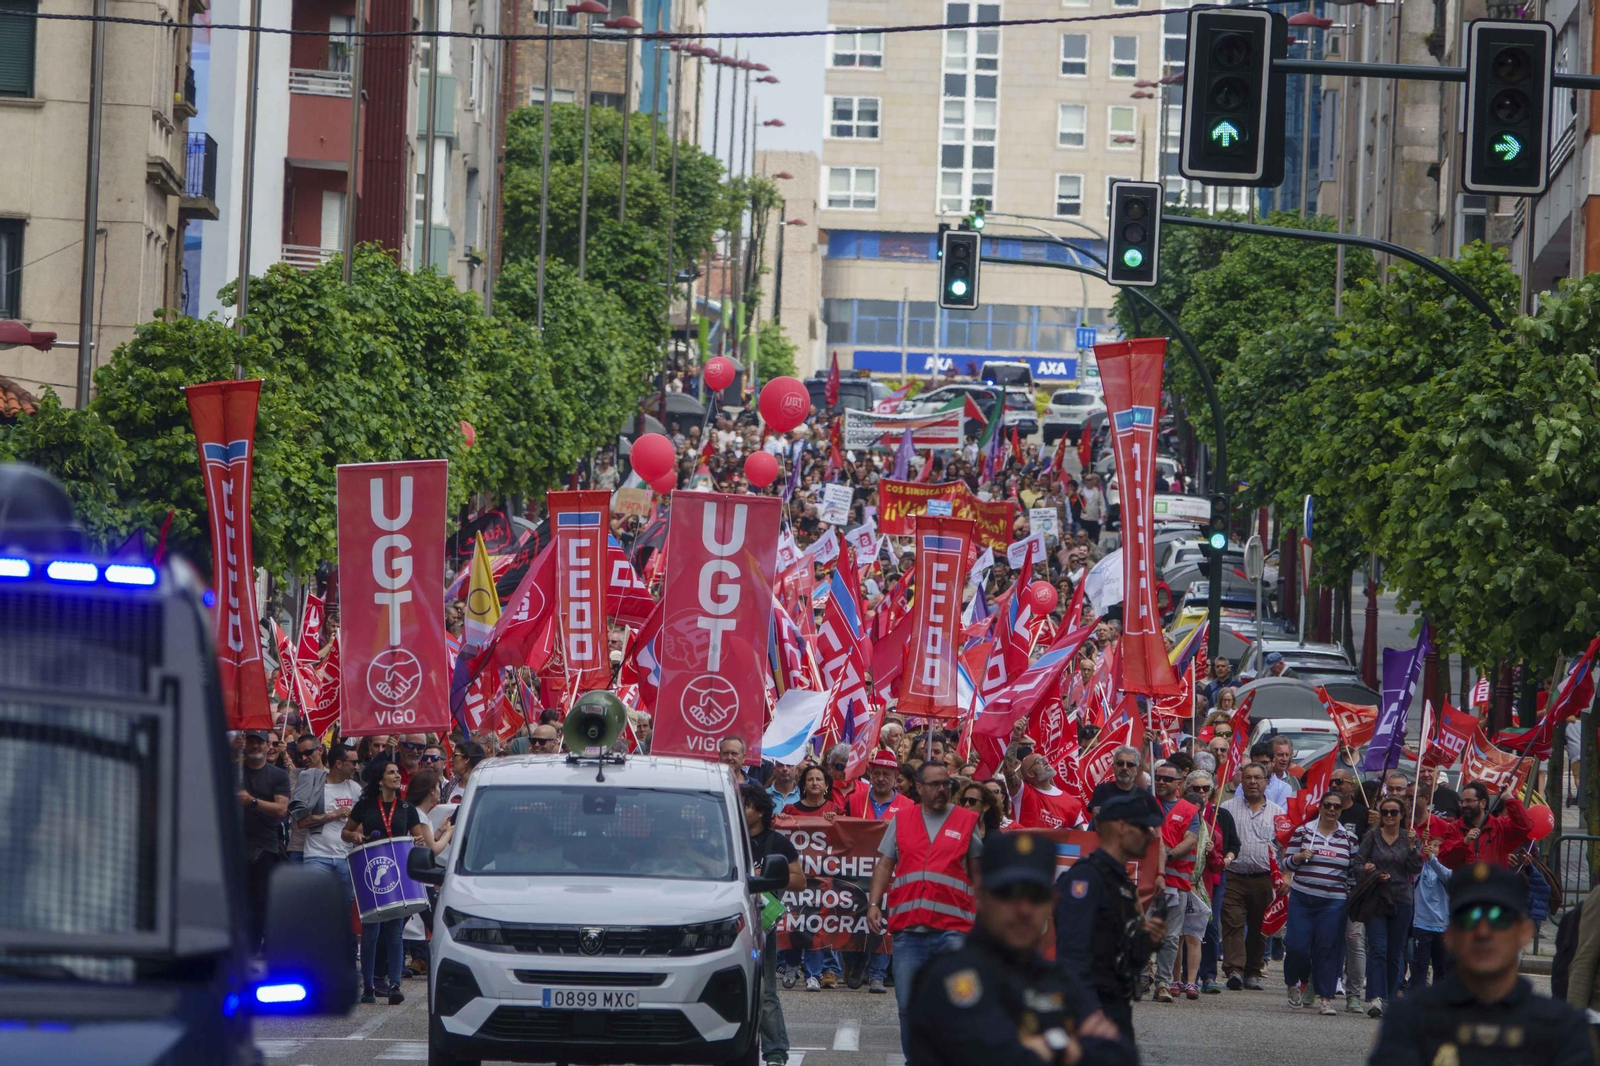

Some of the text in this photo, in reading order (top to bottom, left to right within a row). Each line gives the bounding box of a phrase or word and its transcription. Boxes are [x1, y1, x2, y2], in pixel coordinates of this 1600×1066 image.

[1037, 361, 1067, 375] AXA
[785, 396, 803, 408] UGT
[905, 486, 956, 496] SINDICATOS
[369, 475, 413, 646] UGT
[697, 502, 748, 672] UGT
[568, 538, 593, 661] CCOO
[922, 563, 948, 686] CCOO
[374, 709, 416, 725] VIGO
[1090, 751, 1114, 784] UG
[555, 991, 635, 1007] 0899 MXC
